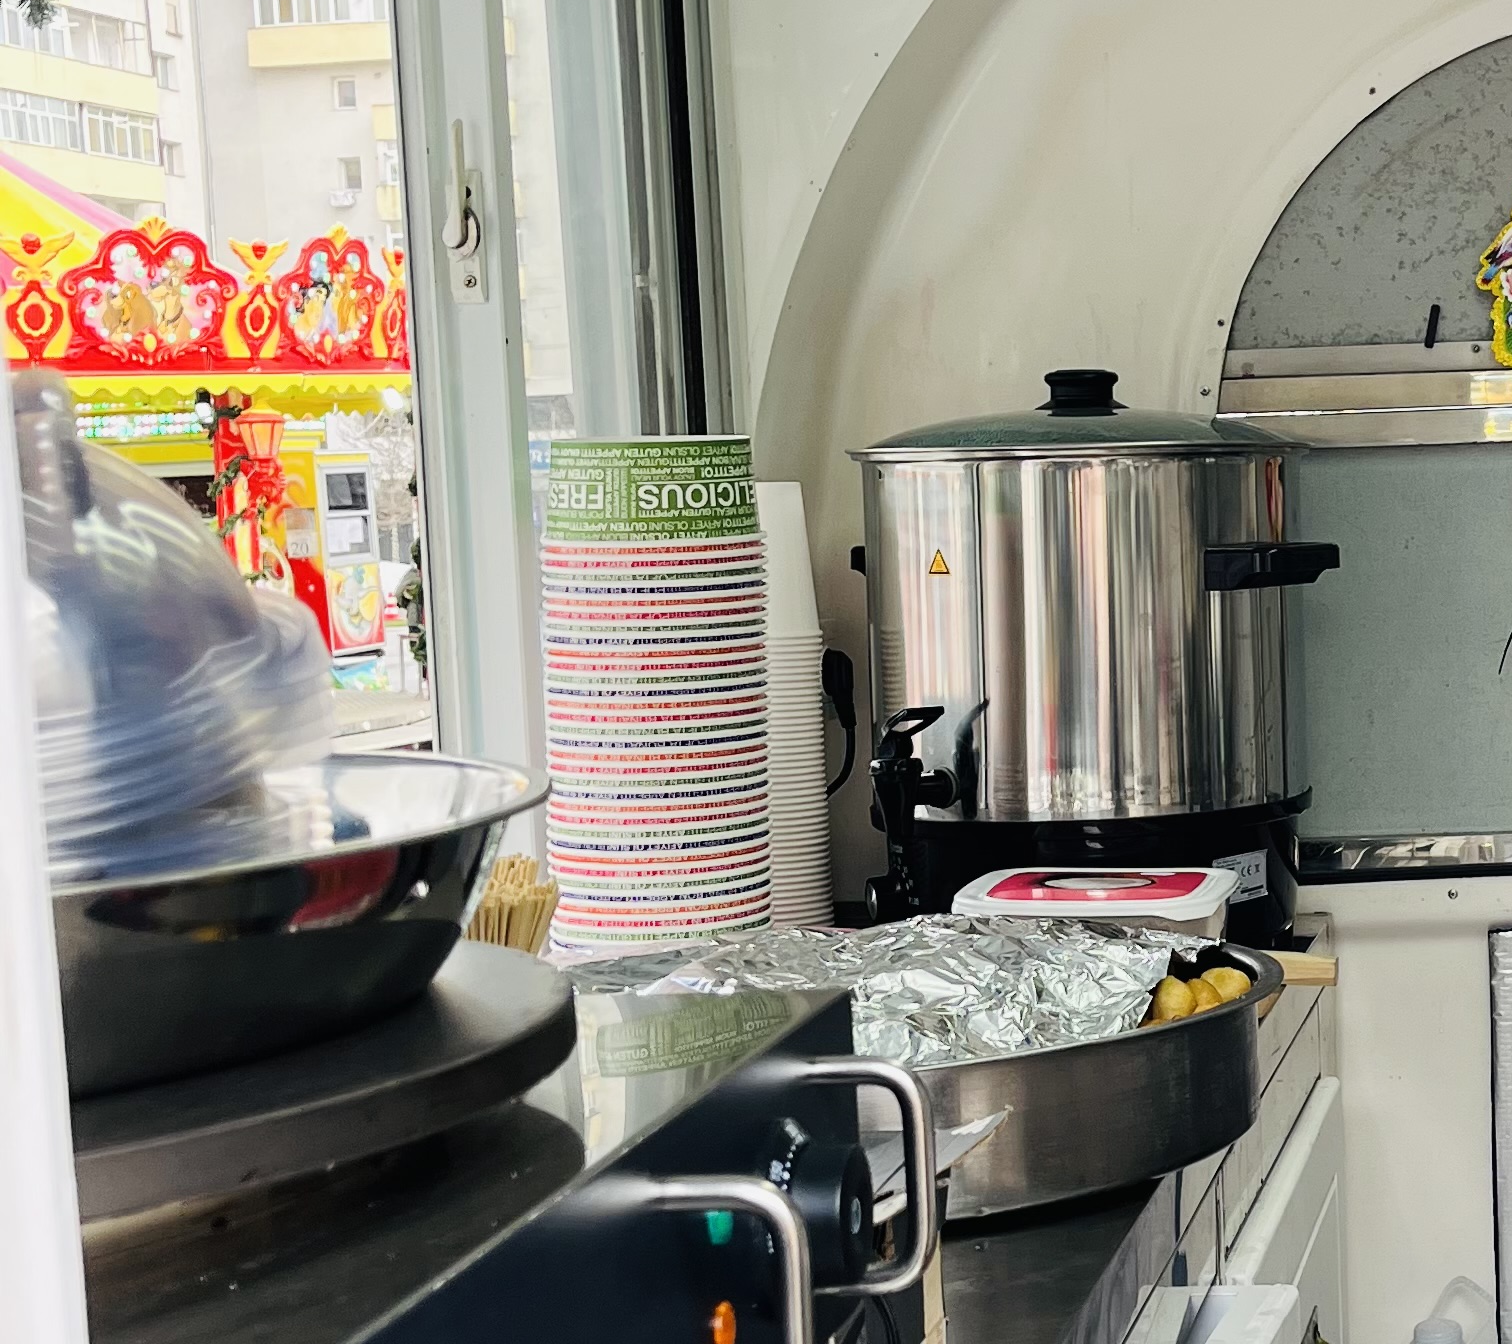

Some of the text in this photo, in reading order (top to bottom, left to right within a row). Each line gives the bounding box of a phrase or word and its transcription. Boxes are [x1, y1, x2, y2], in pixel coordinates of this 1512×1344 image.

[624, 448, 662, 458] GUTEN
[609, 522, 647, 531] GUTEN
[290, 542, 309, 556] 20
